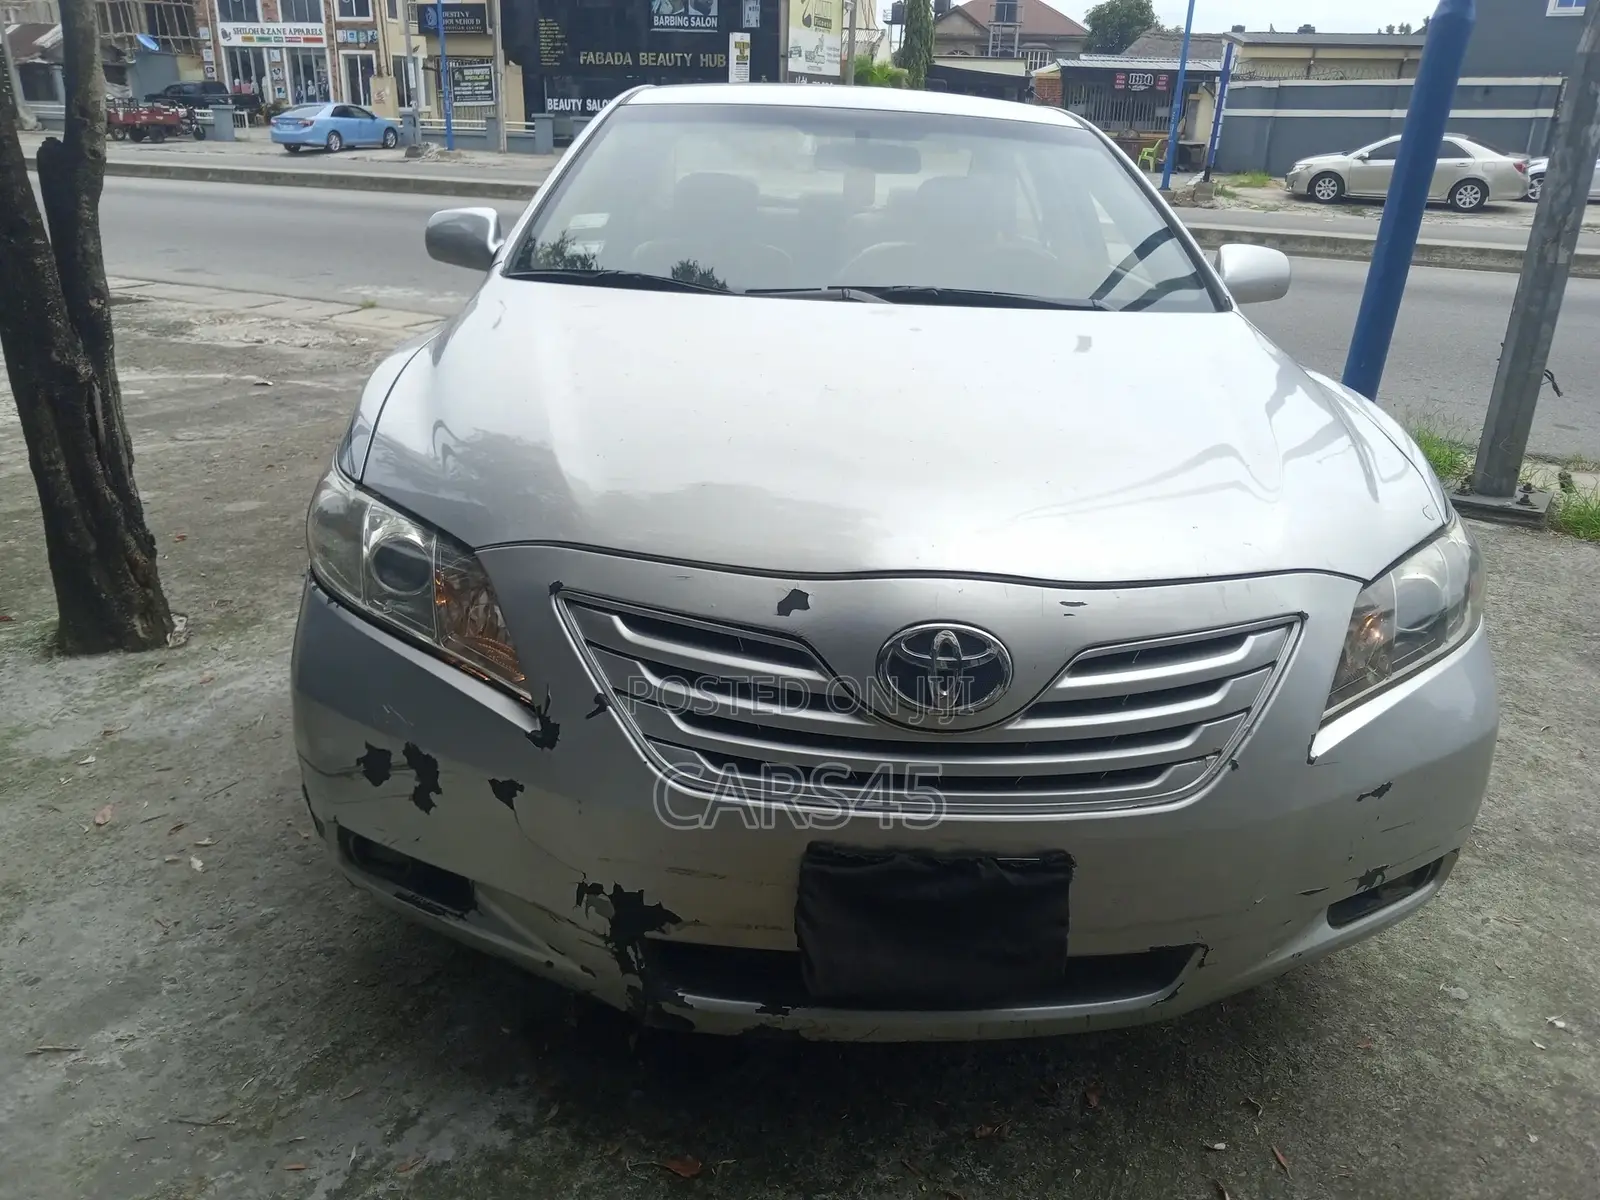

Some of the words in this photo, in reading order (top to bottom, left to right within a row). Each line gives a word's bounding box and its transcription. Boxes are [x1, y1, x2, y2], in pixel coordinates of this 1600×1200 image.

[654, 16, 689, 27] BARBING
[690, 17, 718, 28] SALON
[266, 28, 287, 36] ZANE
[289, 28, 323, 36] APPARELS
[580, 52, 633, 65] FABADA
[639, 53, 693, 67] BEAUTY
[700, 54, 727, 68] HUB
[1129, 74, 1154, 85] BBQ
[547, 98, 583, 111] BEAUTY
[586, 99, 613, 111] SALO
